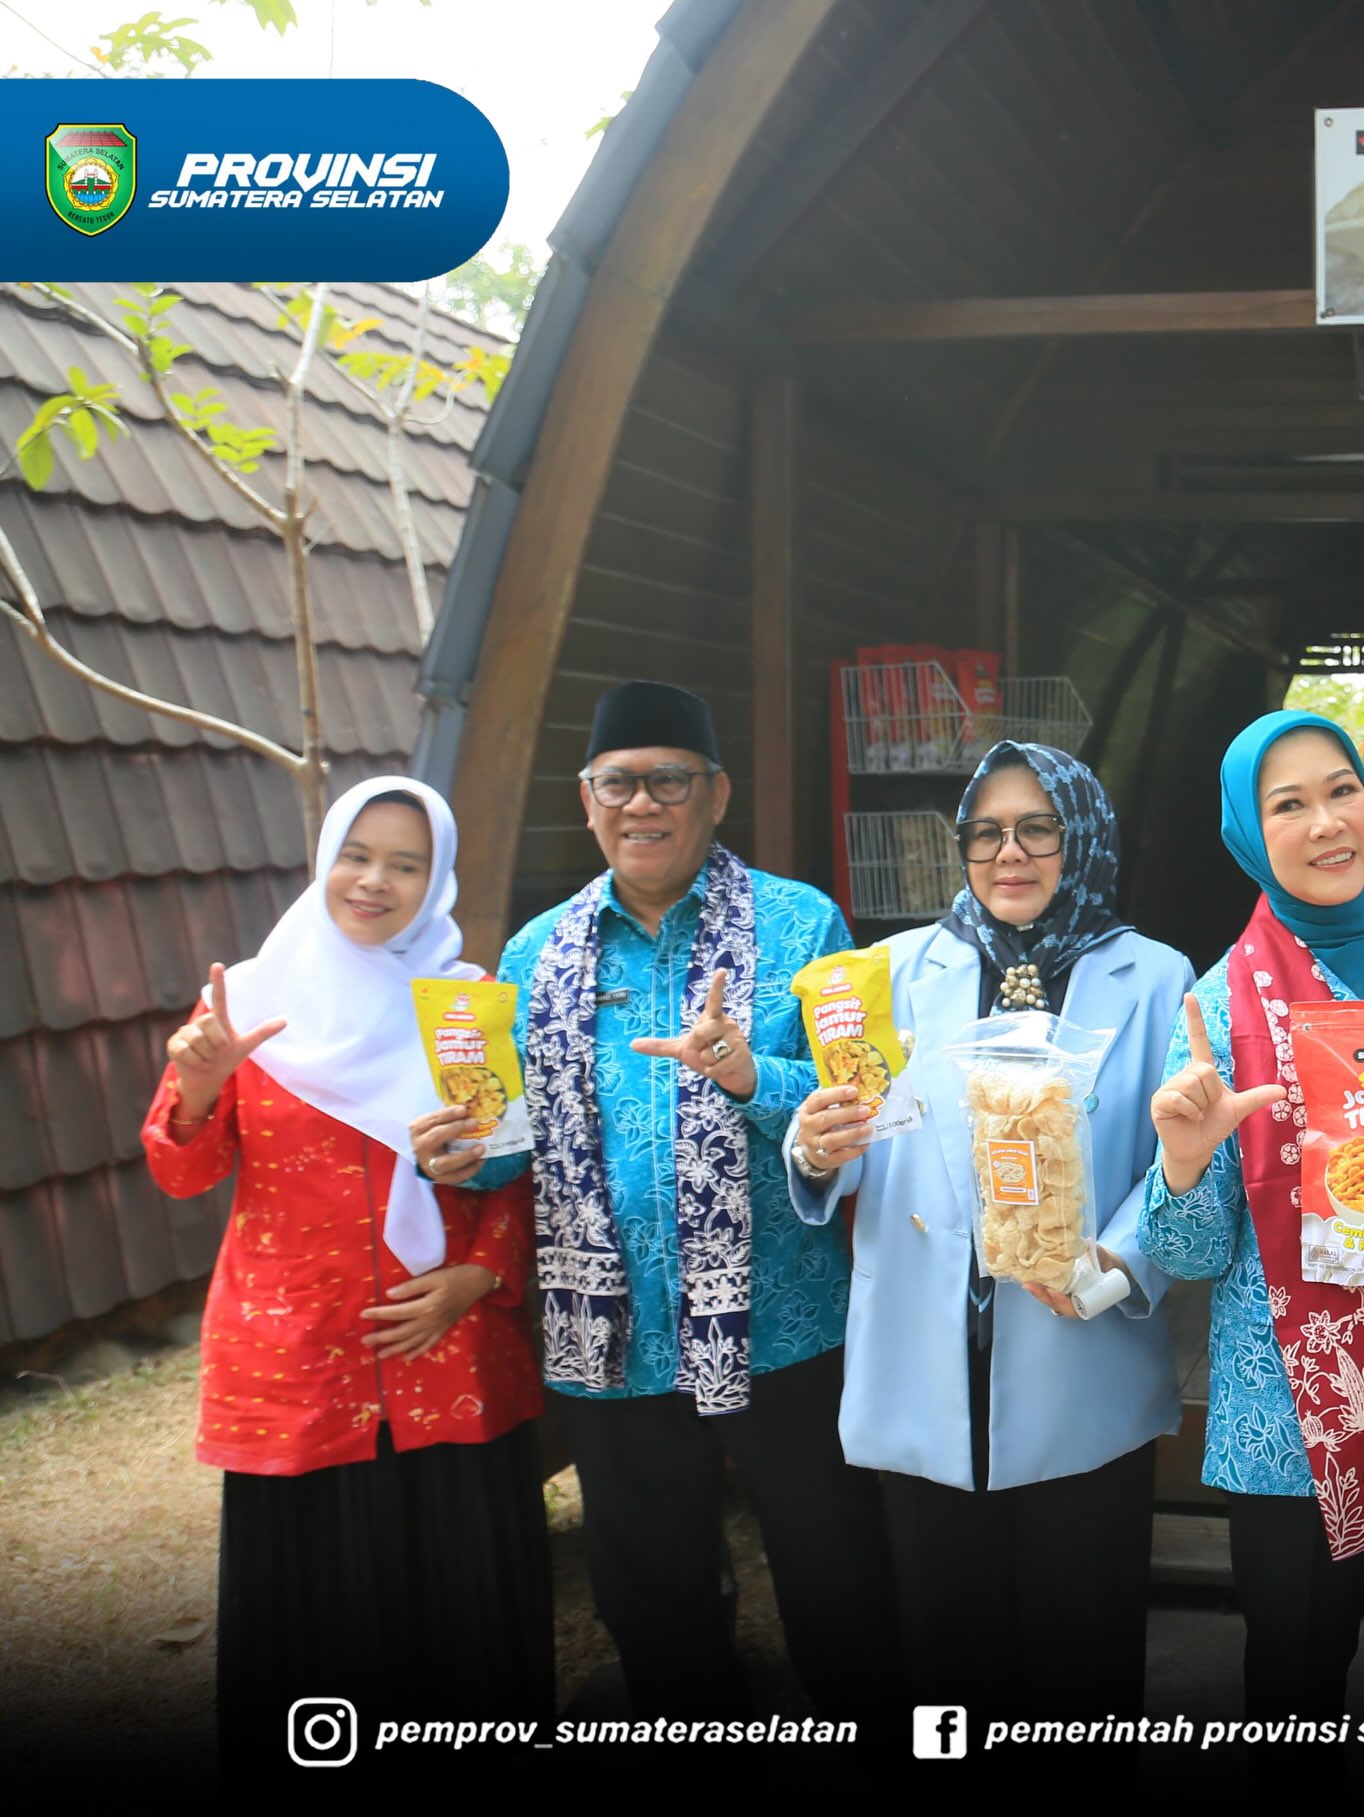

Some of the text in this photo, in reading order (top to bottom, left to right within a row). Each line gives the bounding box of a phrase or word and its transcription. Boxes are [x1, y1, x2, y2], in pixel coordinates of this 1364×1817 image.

[813, 996, 862, 1019] Pangsit
[818, 1023, 863, 1047] TIRAM
[436, 1050, 485, 1066] TIRAM
[1343, 1236, 1355, 1249] &
